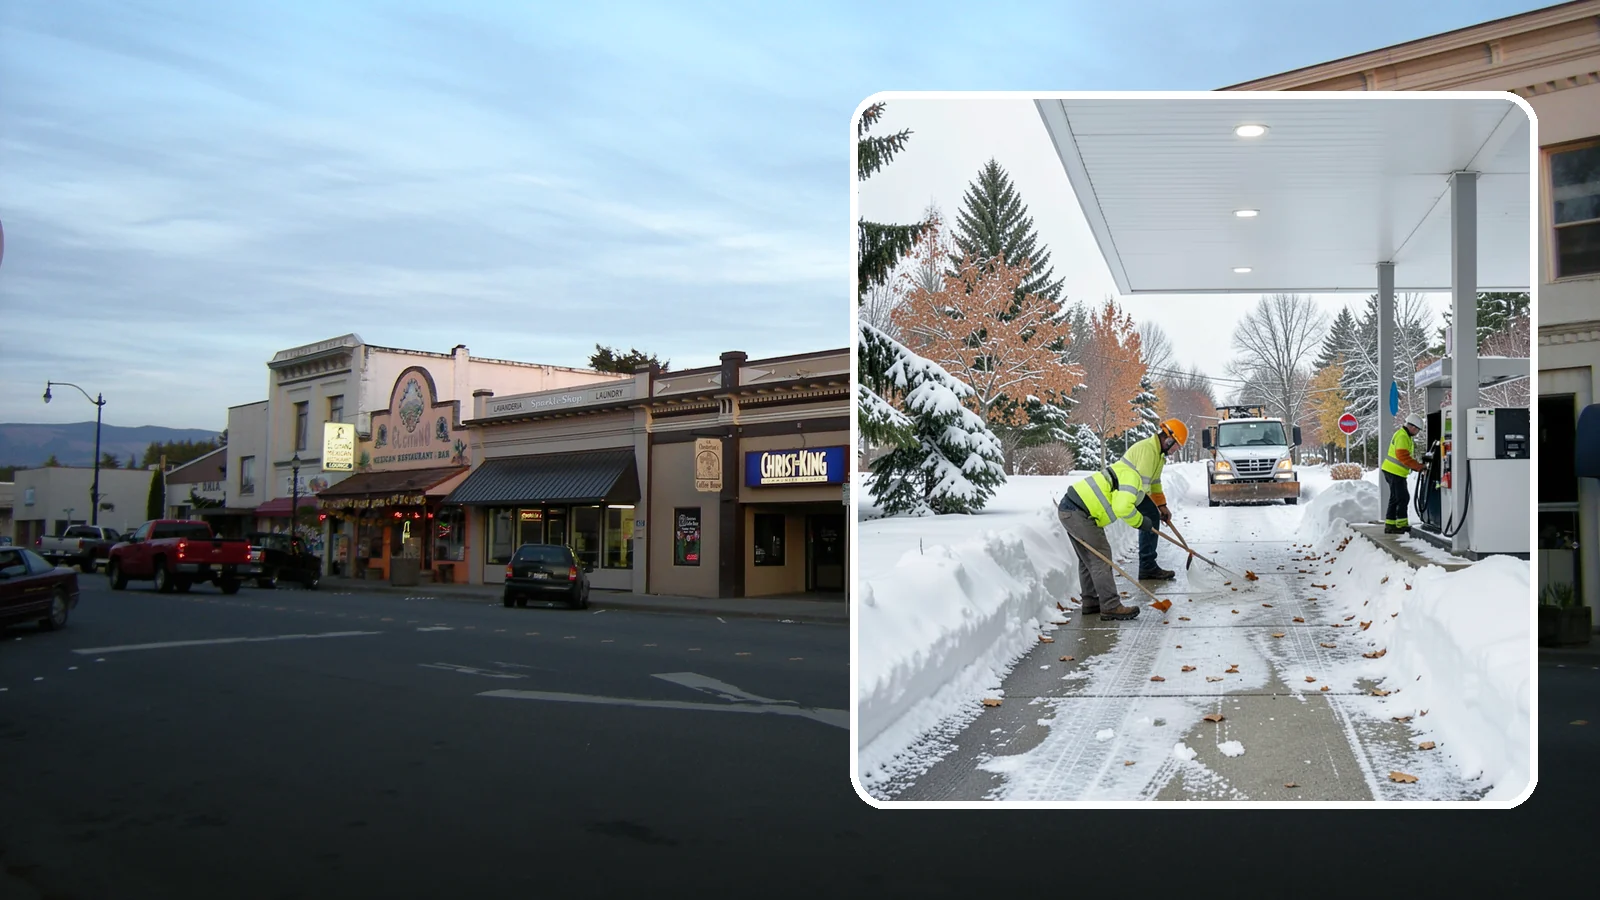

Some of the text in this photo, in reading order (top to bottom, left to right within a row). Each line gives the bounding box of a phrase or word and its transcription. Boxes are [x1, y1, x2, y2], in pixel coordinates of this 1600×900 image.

[493, 402, 522, 412] LAVANDERIA
[561, 395, 582, 405] Shop
[596, 389, 623, 400] LAUNDRY
[398, 451, 433, 462] RESTAURANT
[438, 450, 450, 459] BAR
[761, 450, 827, 478] CHRIST KING
